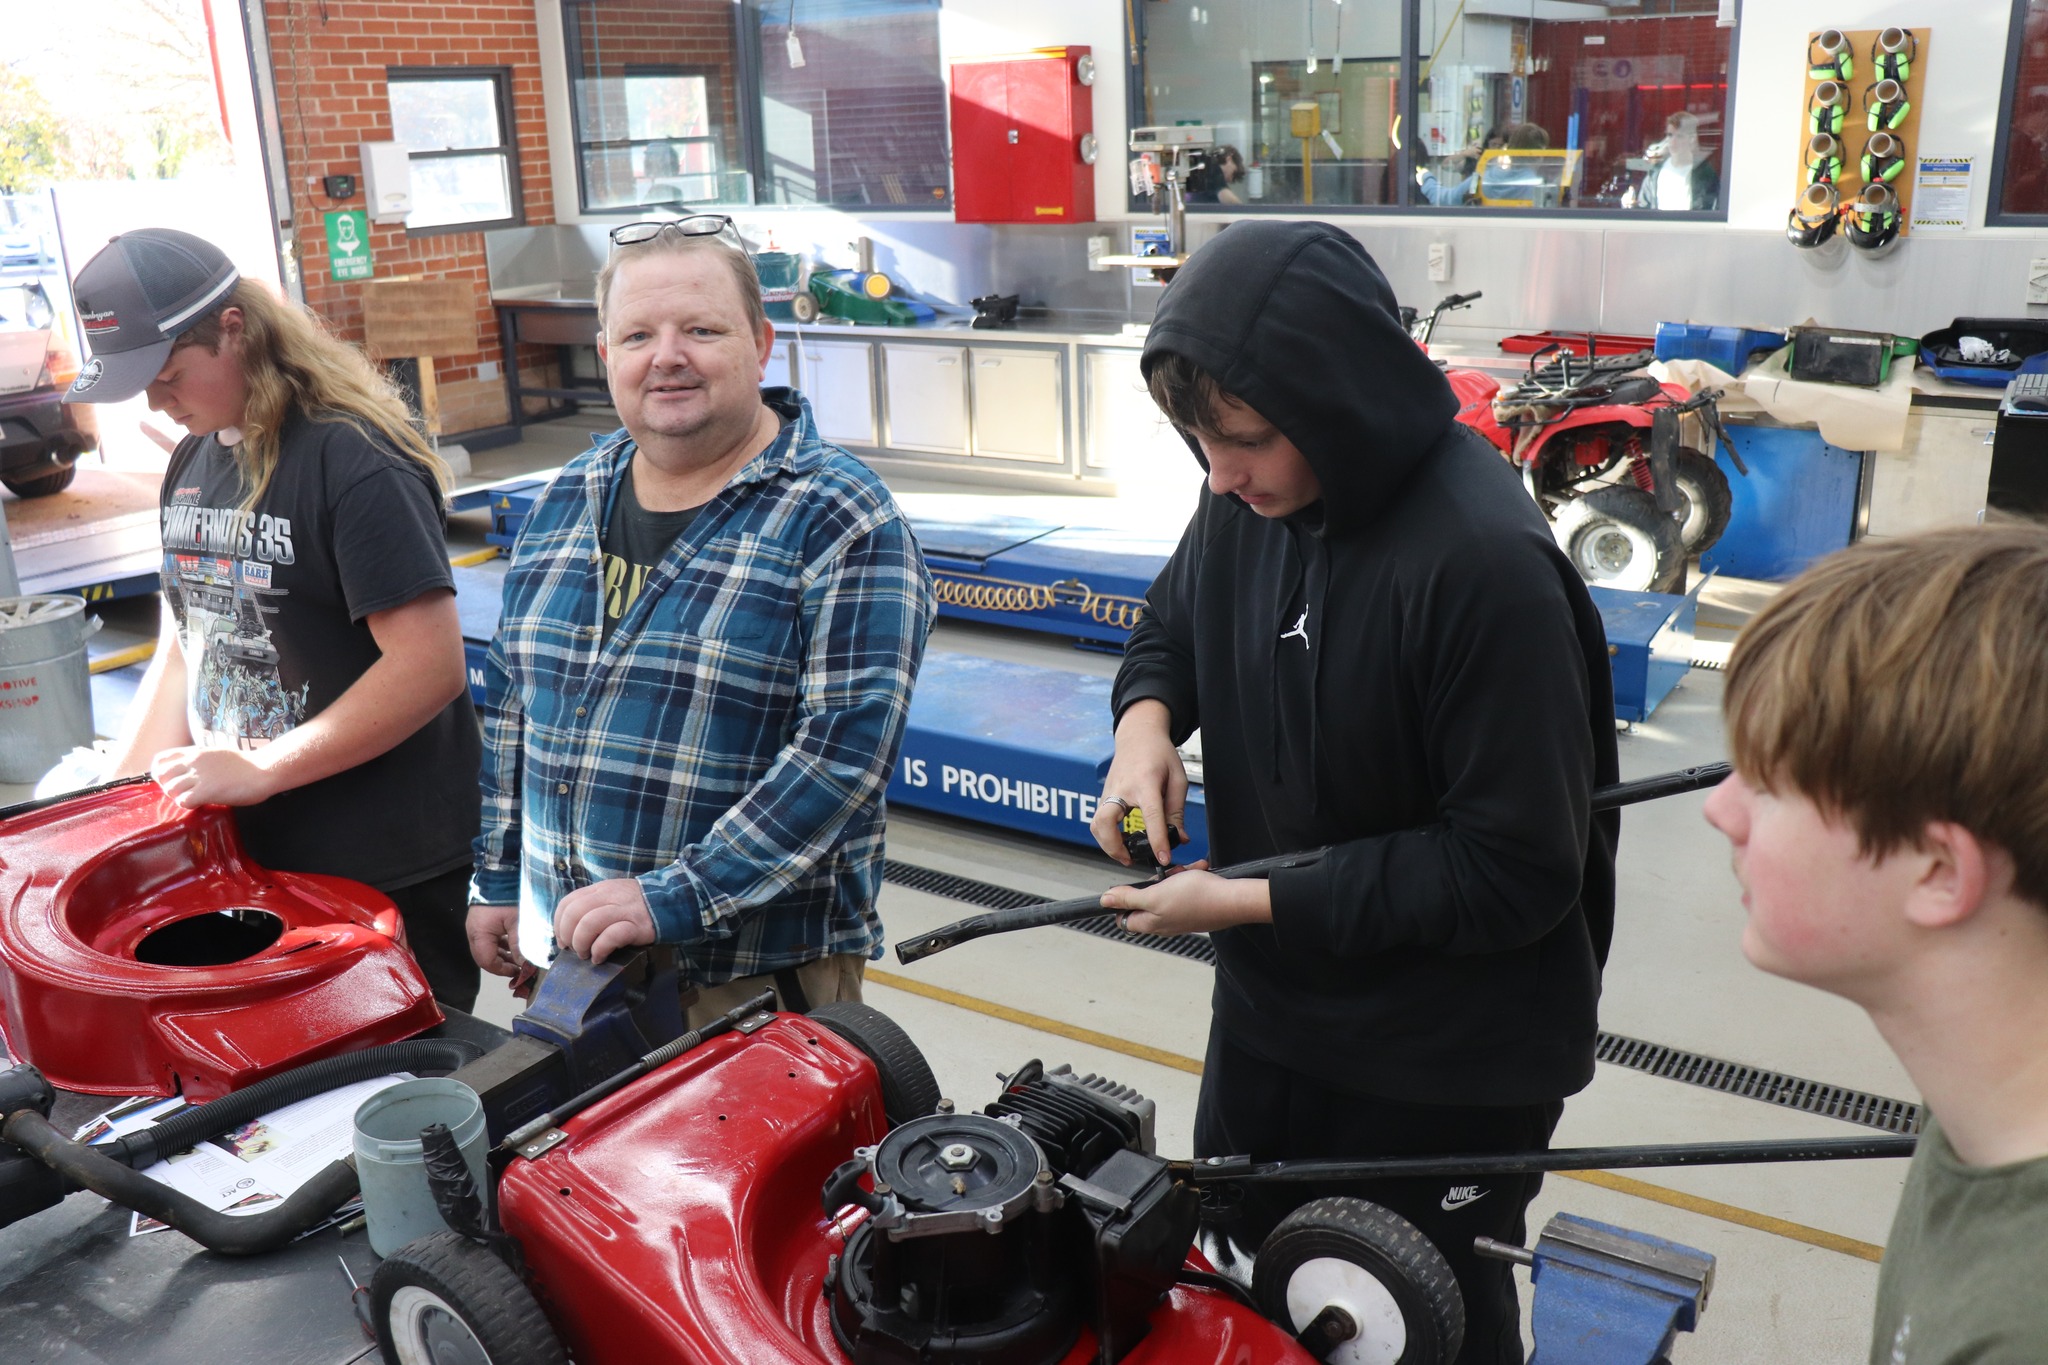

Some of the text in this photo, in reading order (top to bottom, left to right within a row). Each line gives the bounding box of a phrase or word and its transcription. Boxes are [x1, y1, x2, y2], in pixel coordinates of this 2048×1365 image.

[257, 513, 295, 565] 35
[245, 566, 269, 579] RARE
[904, 757, 1101, 825] IS PROHIBITE
[222, 1189, 237, 1198] ACT
[1448, 1185, 1479, 1200] NIKE
